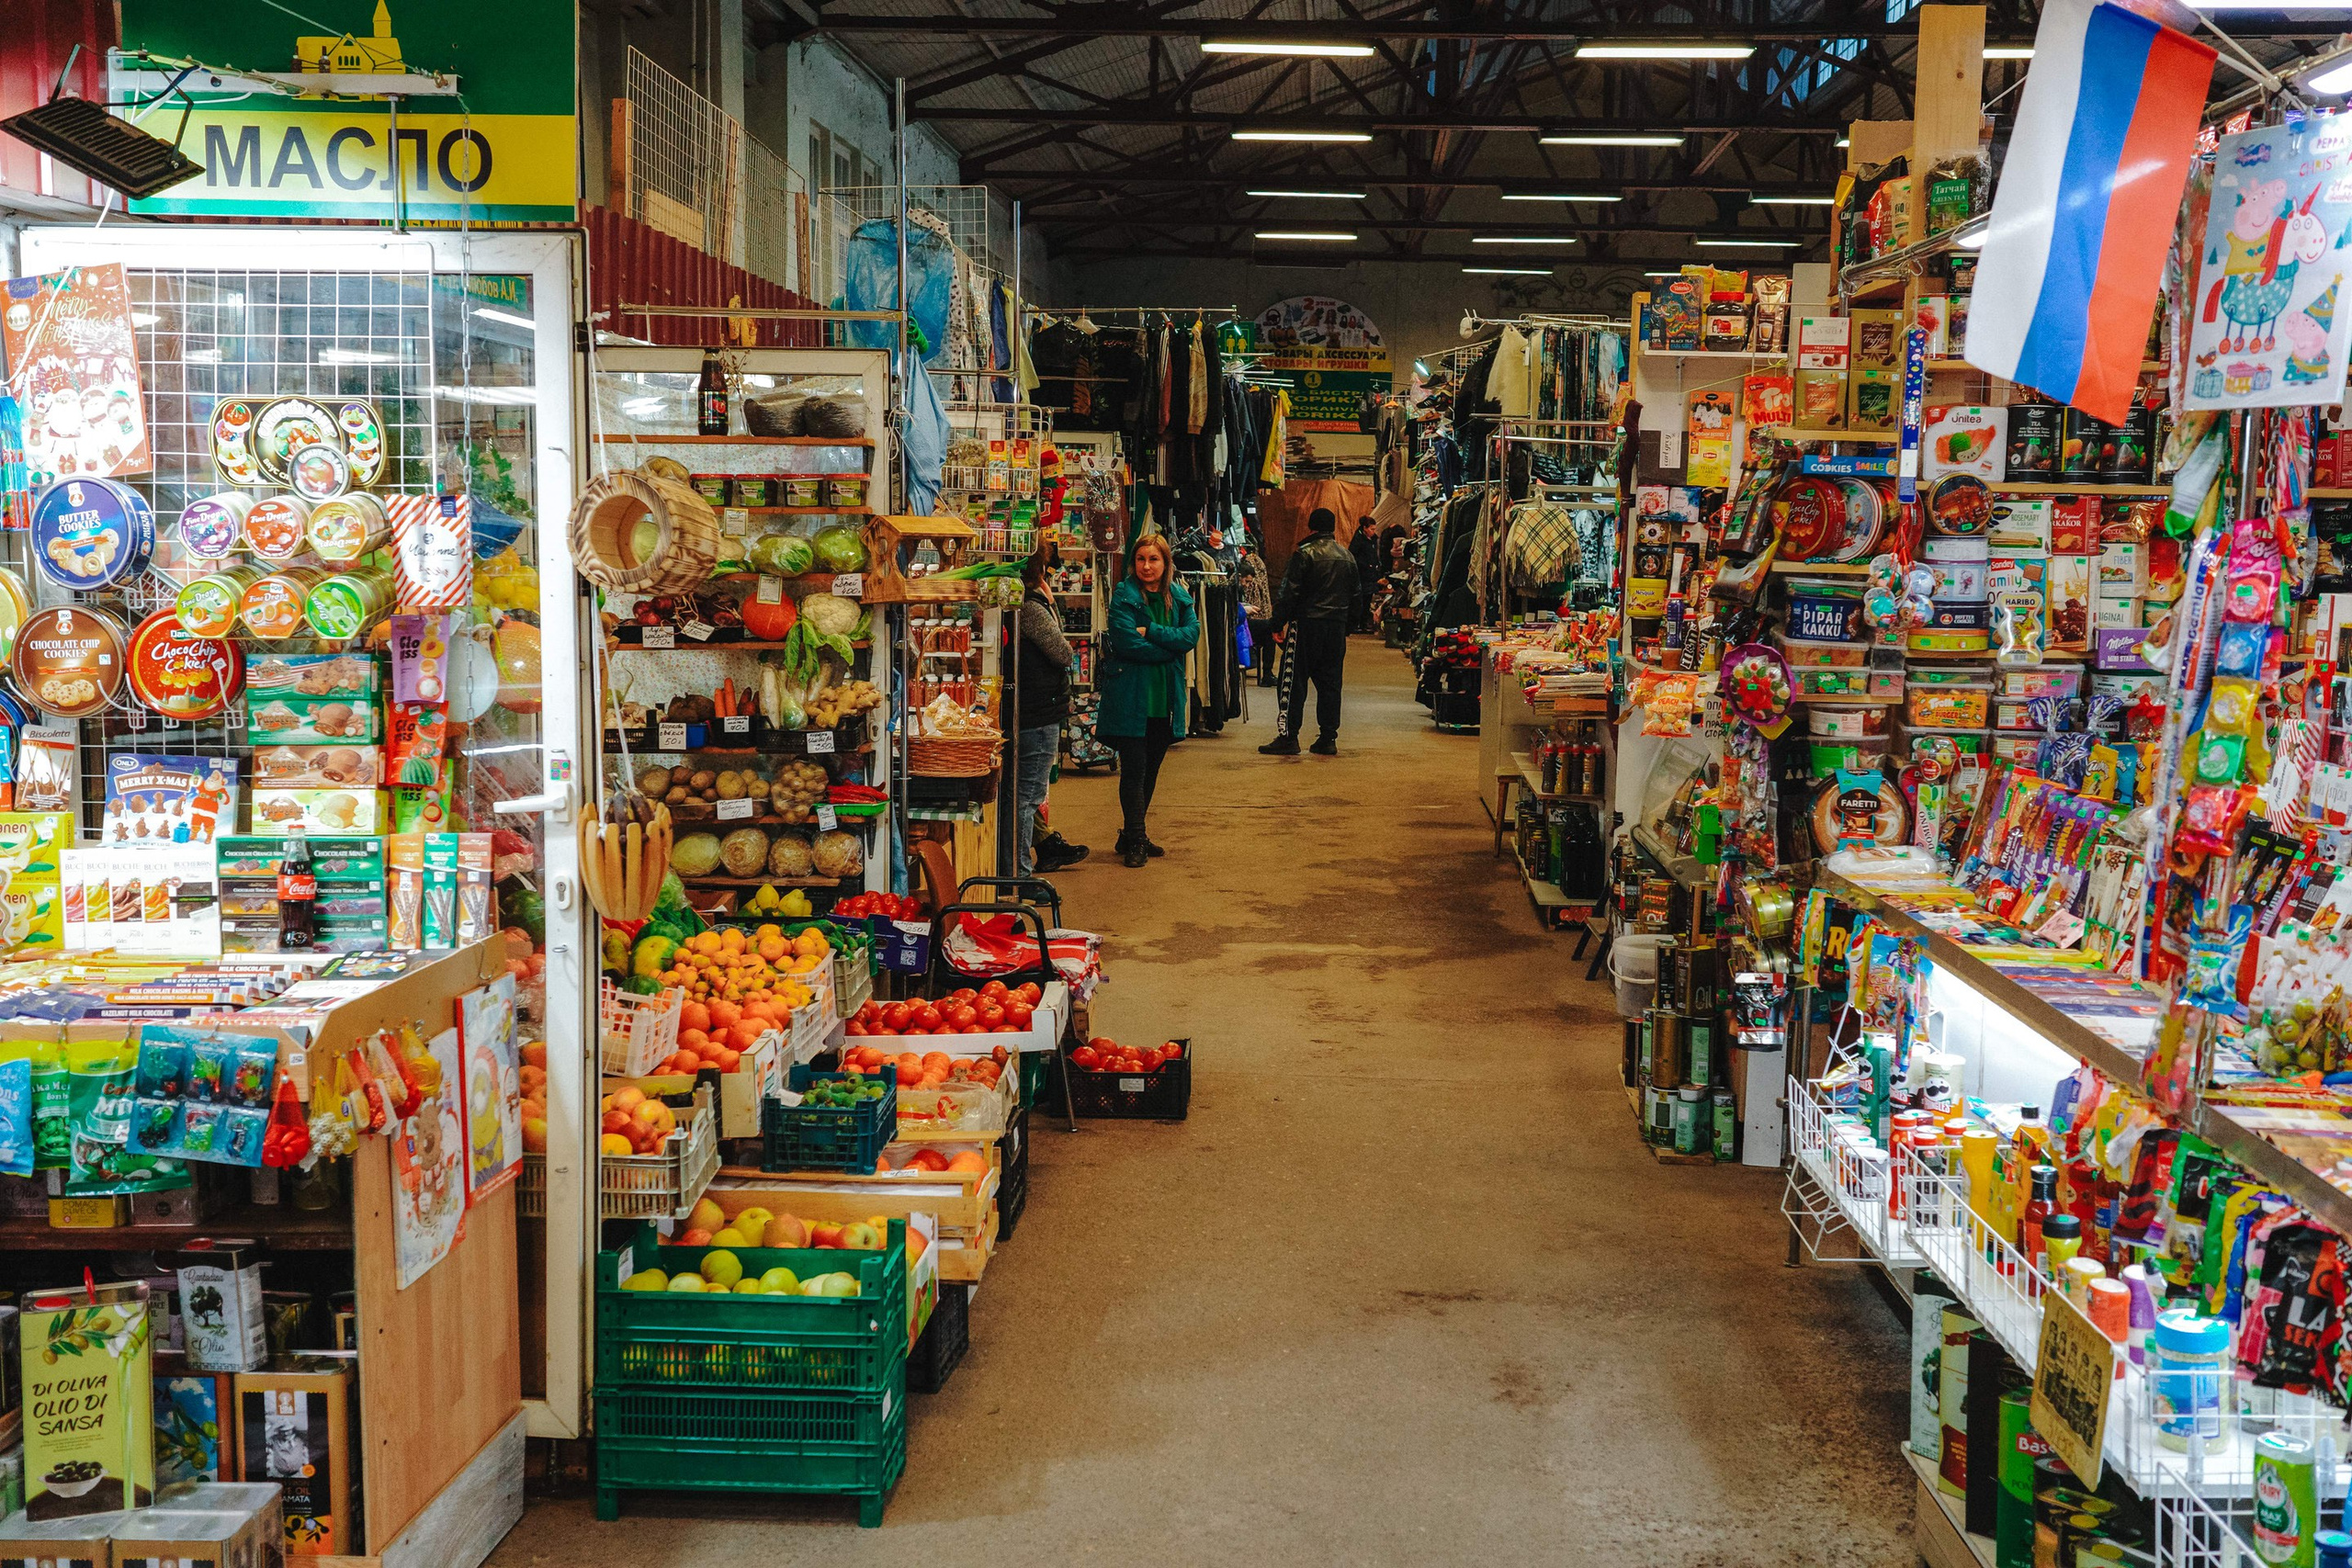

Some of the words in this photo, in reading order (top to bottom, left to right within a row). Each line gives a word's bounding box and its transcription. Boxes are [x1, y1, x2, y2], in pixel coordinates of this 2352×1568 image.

[2317, 138, 2345, 149] PEPPA
[204, 125, 493, 193] МАСЛО
[1935, 184, 1966, 194] Татчай
[35, 296, 97, 321] Merry
[1303, 298, 1314, 310] 2
[1863, 333, 1890, 348] Truffles
[1317, 351, 1386, 359] АКСЕССУАРЫ
[1317, 360, 1369, 369] ИГРУШКИ
[1860, 394, 1888, 410] Truffles
[1754, 412, 1791, 424] MULTI
[1810, 463, 1852, 474] COOKIES
[1855, 461, 1884, 472] SMILE
[59, 510, 98, 525] BUTTER
[200, 510, 229, 521] Drops
[266, 510, 294, 520] Drops
[2011, 514, 2040, 524] ROSEMARY
[59, 519, 101, 534] COOKIES
[1991, 560, 2014, 570] Sondey
[2114, 555, 2132, 564] FIBER
[195, 588, 219, 602] Drops
[265, 592, 289, 602] Drops
[1804, 611, 1843, 625] PIPAR
[1803, 623, 1841, 637] KAKKU
[30, 640, 78, 649] CHOCOLATE
[80, 639, 100, 649] CHIP
[2107, 637, 2135, 649] Milka
[44, 649, 87, 659] COOKIES
[28, 730, 71, 739] Biscolata
[119, 775, 153, 788] MERRY
[1841, 799, 1877, 808] FARETTI
[32, 1382, 52, 1396] DI
[57, 1375, 107, 1393] OLIVA
[33, 1398, 79, 1418] OLIO
[85, 1394, 107, 1410] DI
[38, 1415, 103, 1436] SANSA
